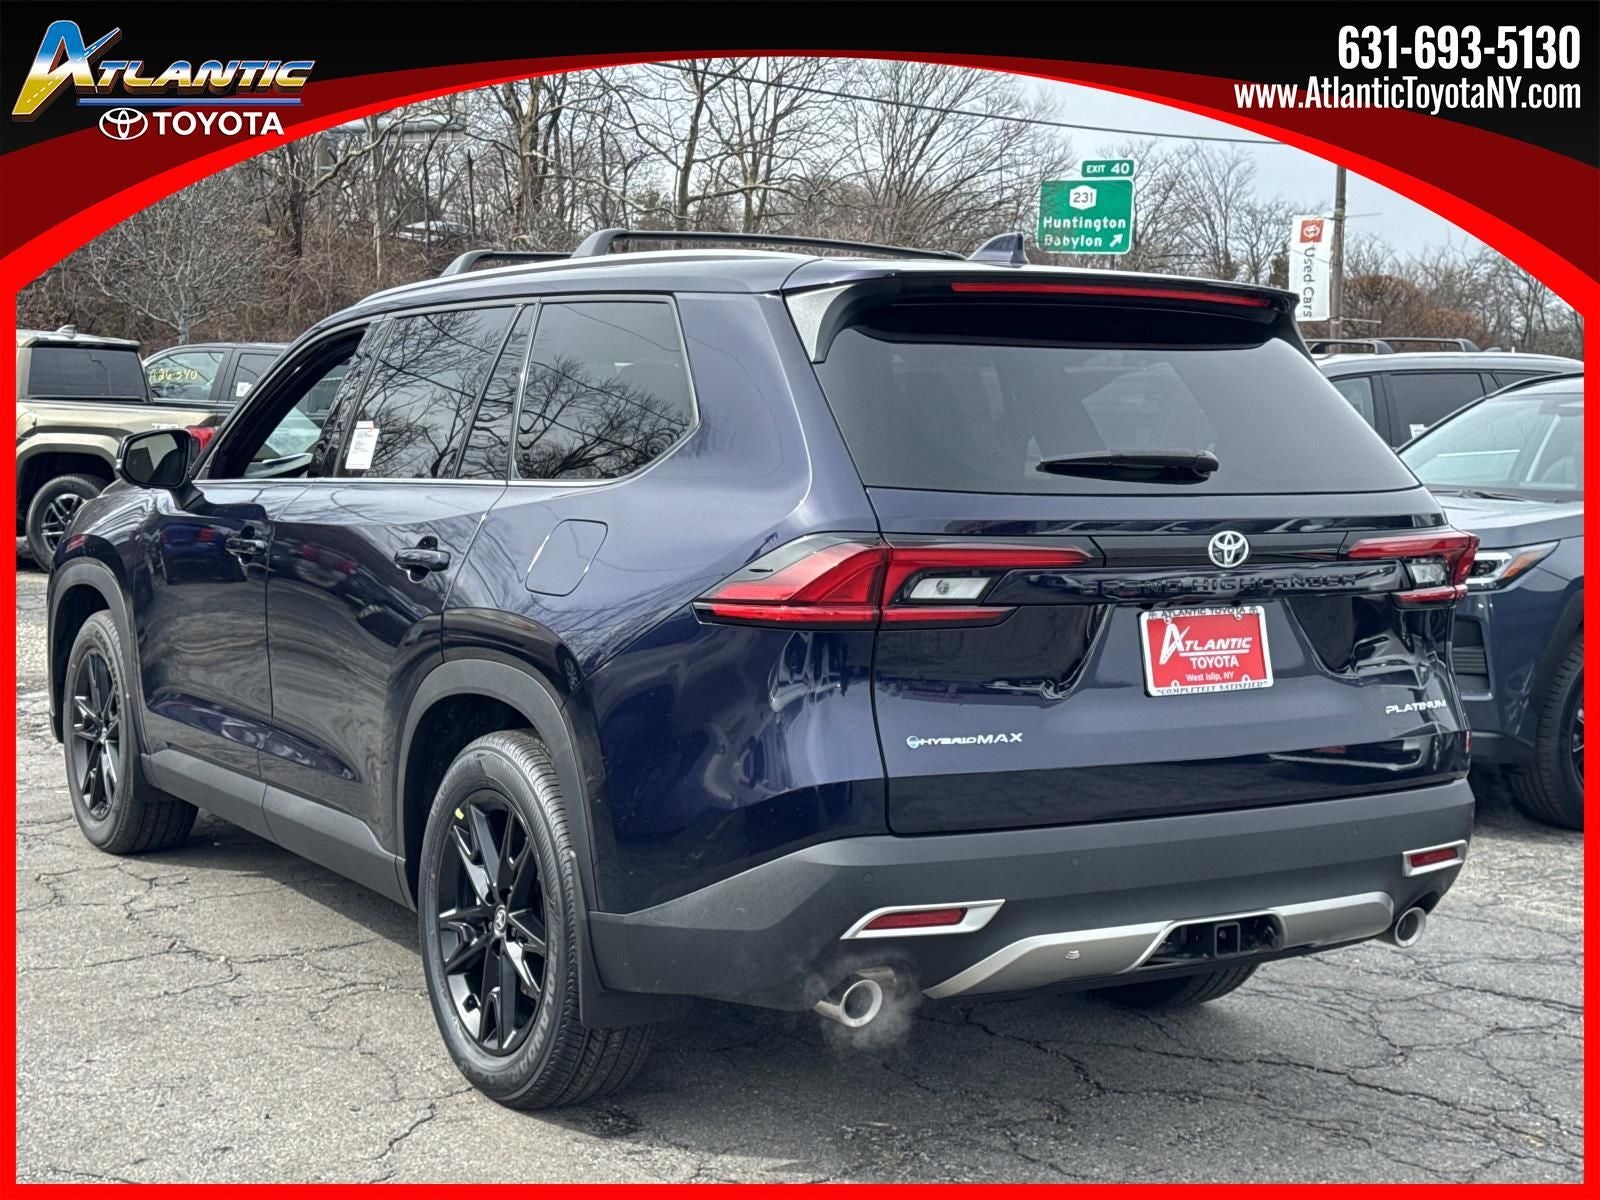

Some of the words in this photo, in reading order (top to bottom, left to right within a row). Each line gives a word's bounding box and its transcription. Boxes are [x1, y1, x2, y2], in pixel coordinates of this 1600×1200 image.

[1086, 164, 1106, 174] EXIT
[1110, 162, 1130, 175] 40
[1072, 191, 1094, 204] 231
[1043, 216, 1127, 233] Huntington
[1044, 234, 1103, 249] Babylon
[1303, 247, 1316, 283] Used
[1303, 286, 1315, 317] Cars
[1159, 623, 1253, 665] ATLANTIC
[1190, 655, 1240, 670] TOYOTA
[1185, 672, 1204, 682] West
[1223, 671, 1235, 680] NY
[1385, 699, 1447, 714] PLATINUM
